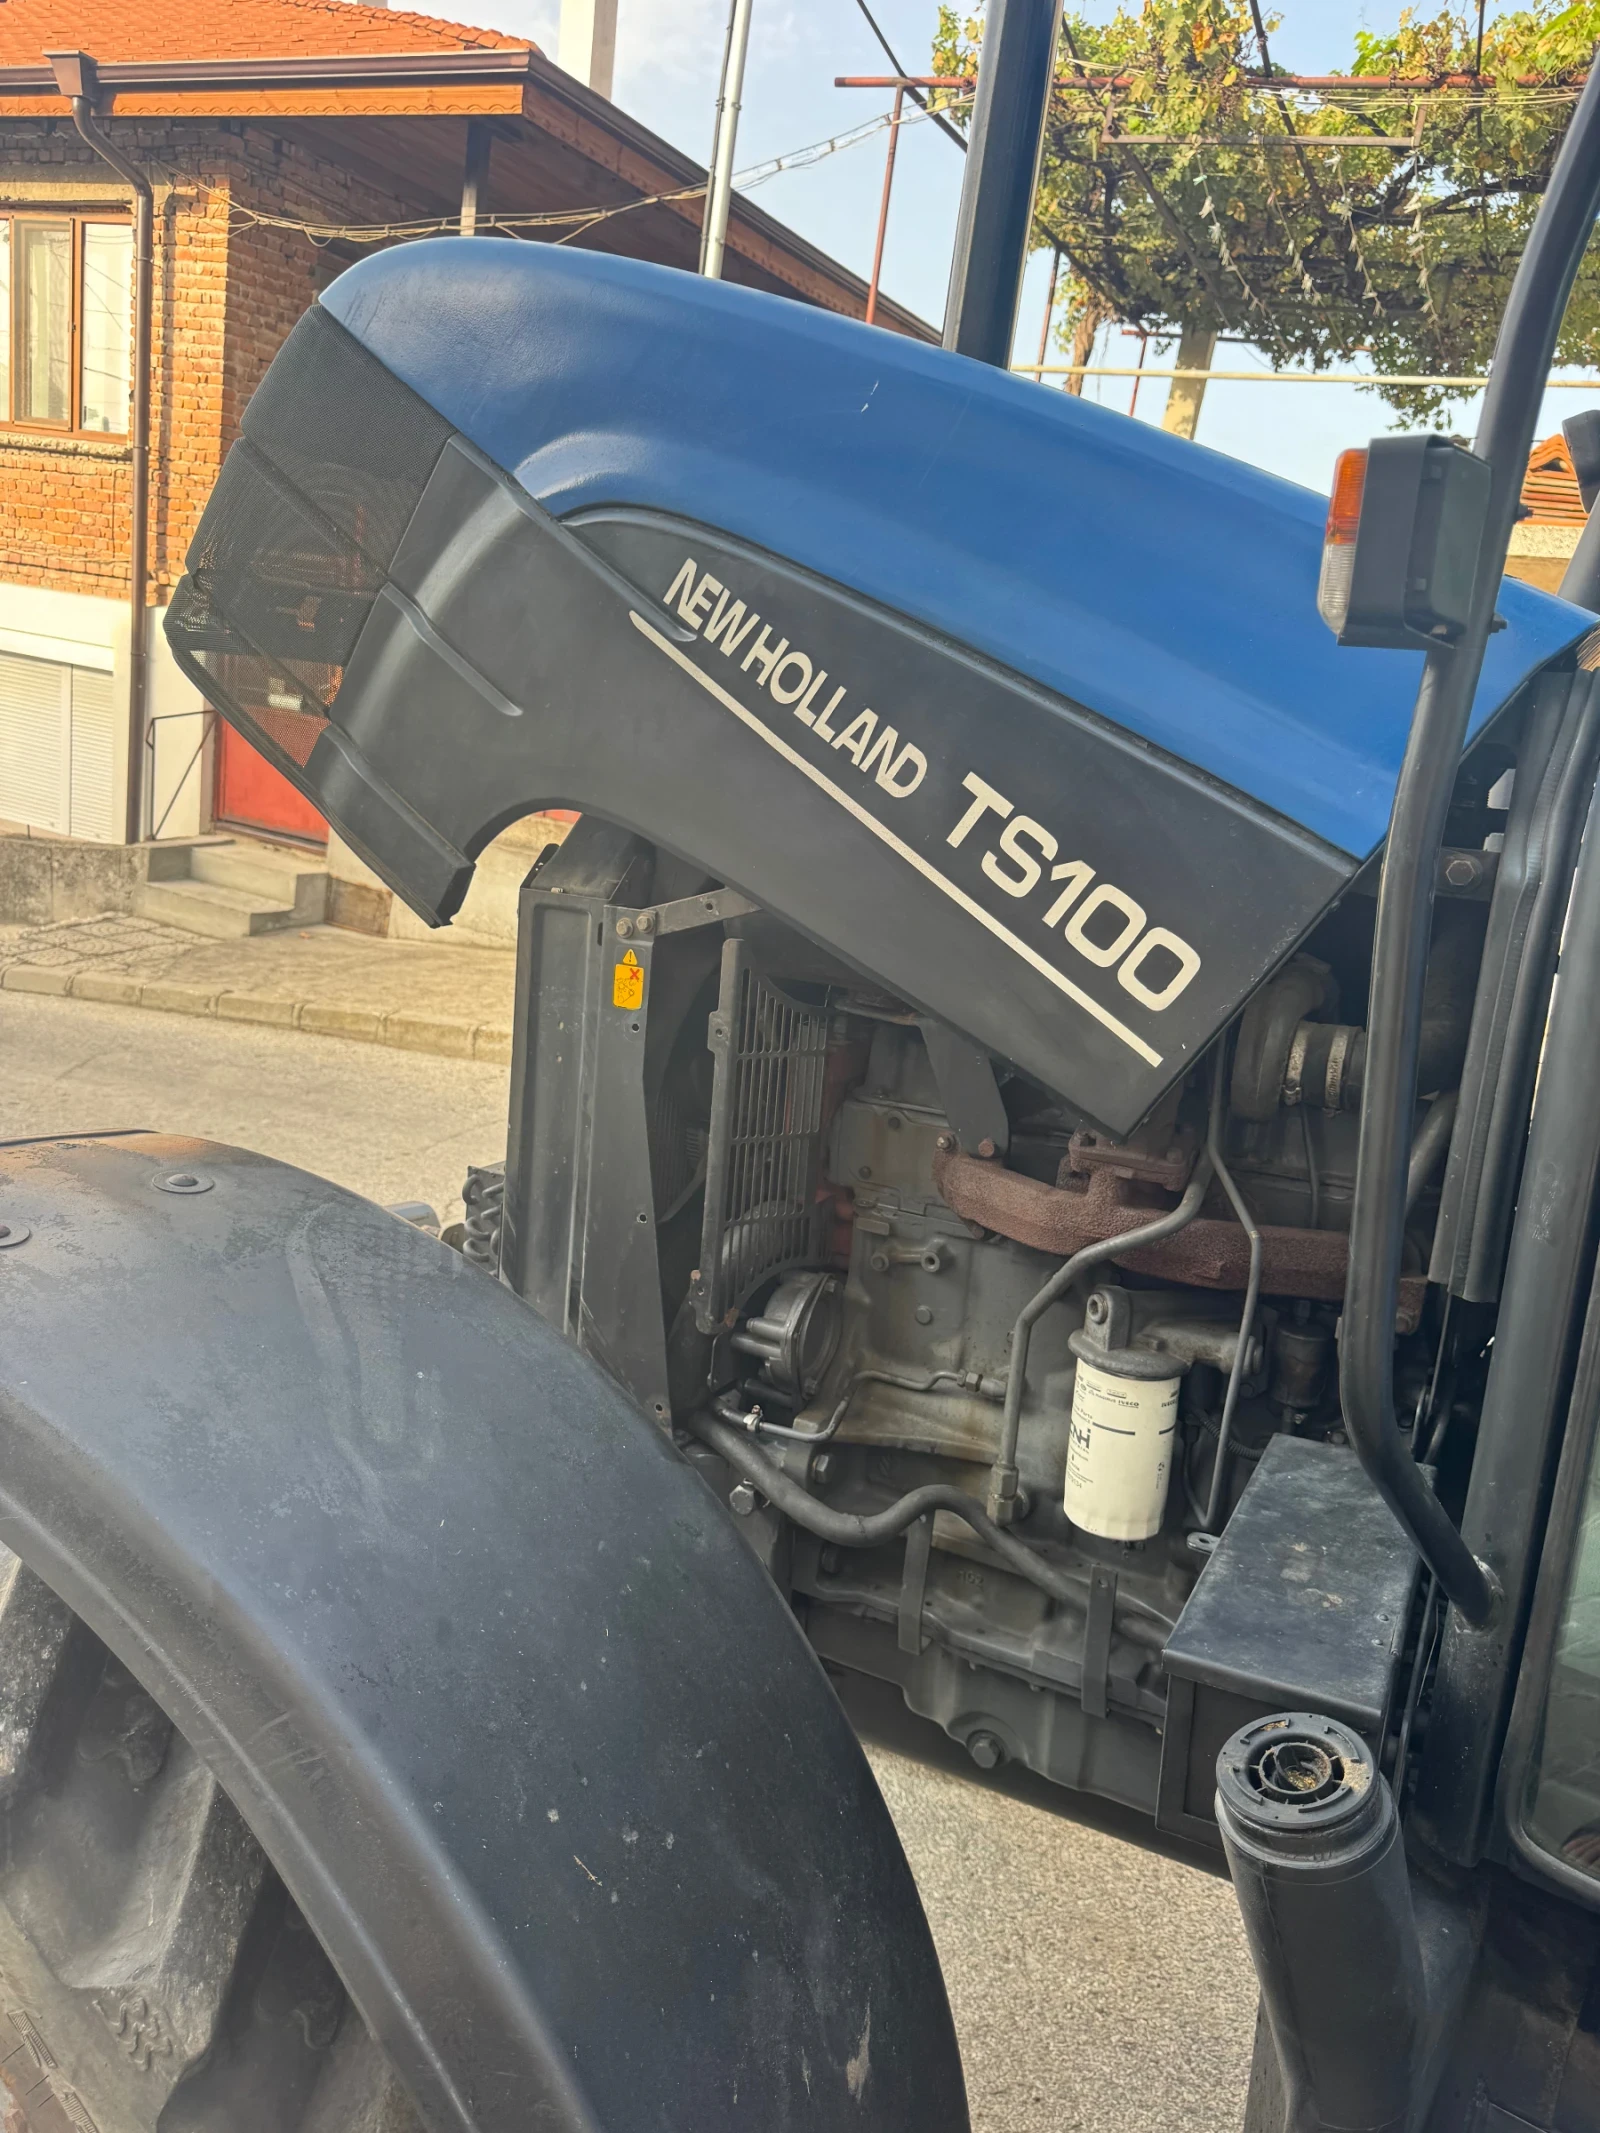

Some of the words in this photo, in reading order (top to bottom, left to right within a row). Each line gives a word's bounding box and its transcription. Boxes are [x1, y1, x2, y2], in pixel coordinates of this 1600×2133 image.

[662, 557, 761, 658] NEW
[739, 622, 928, 798] HOLLAND
[945, 771, 1202, 1012] TS100
[1118, 1399, 1140, 1407] IVECO
